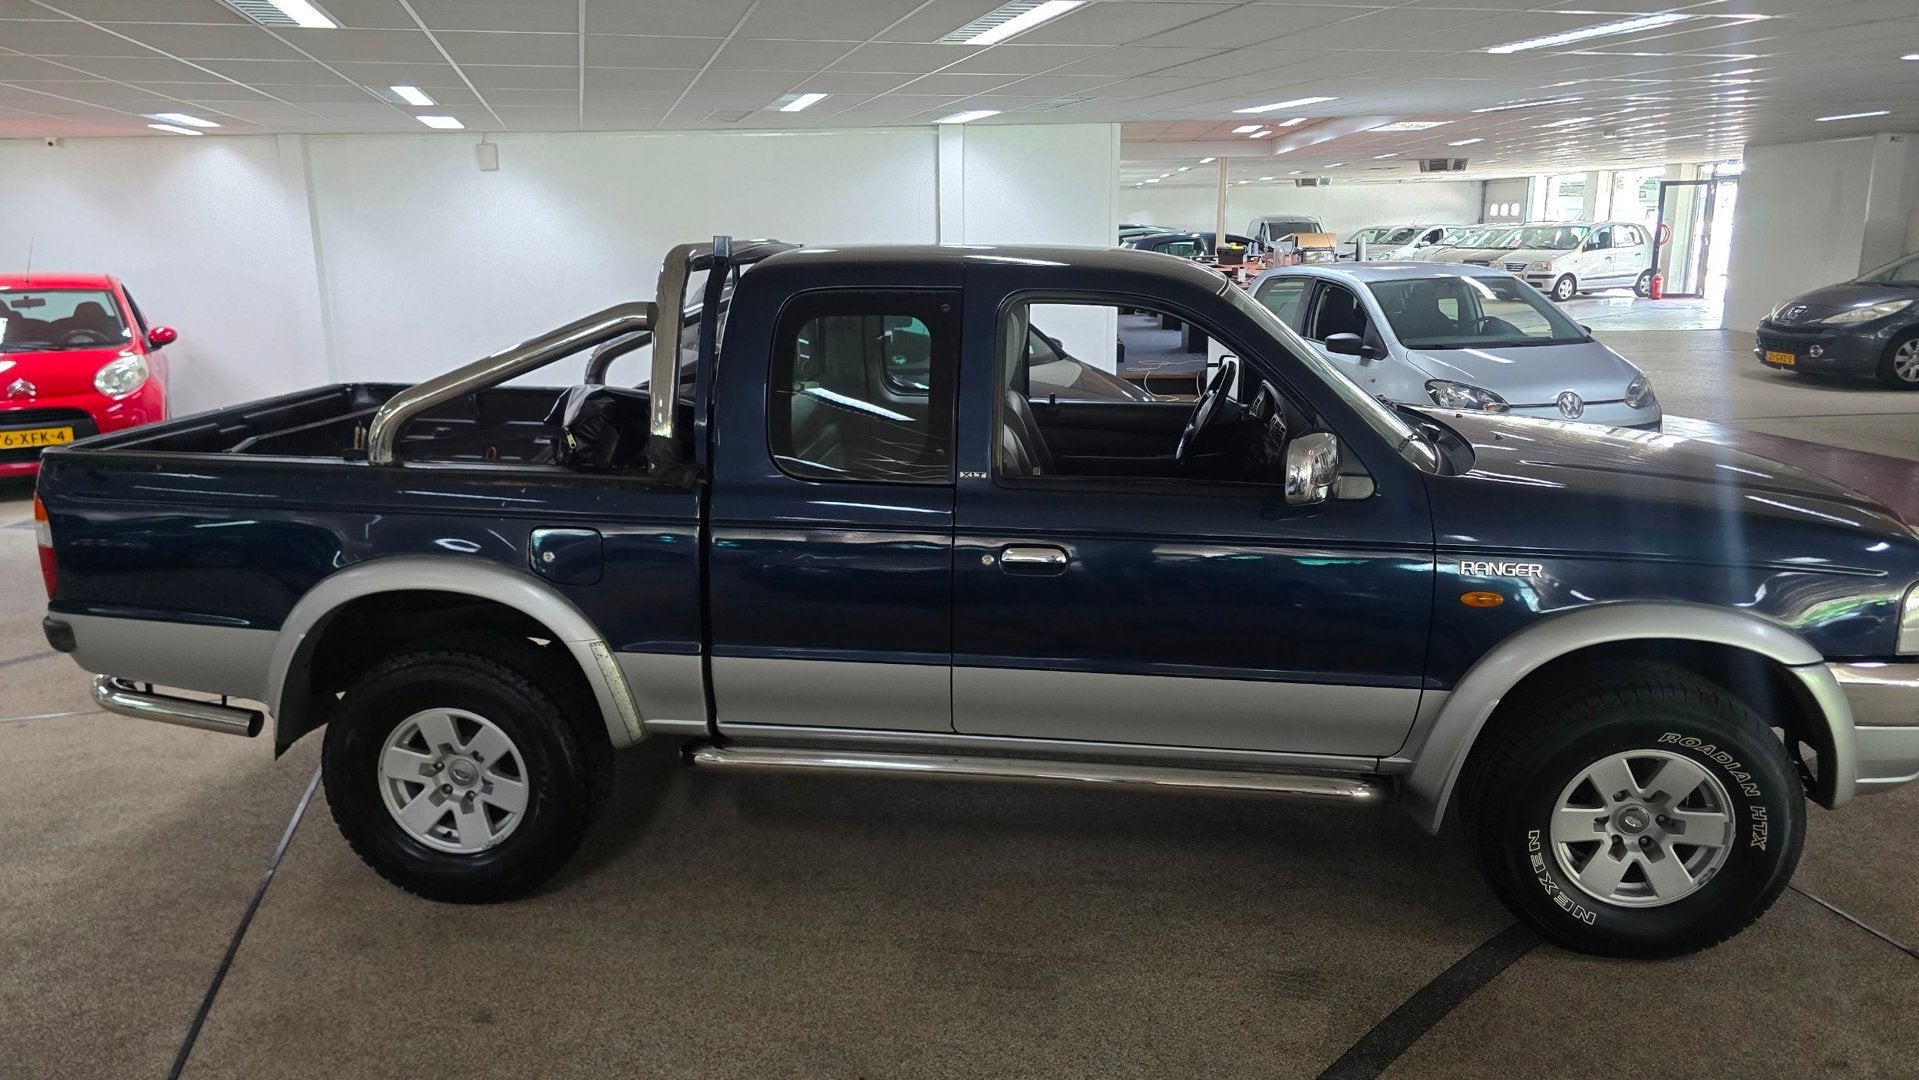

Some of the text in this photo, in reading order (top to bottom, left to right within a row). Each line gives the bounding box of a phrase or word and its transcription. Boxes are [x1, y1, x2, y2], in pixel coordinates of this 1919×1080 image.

[0, 430, 66, 446] 6-XFK-4
[1460, 560, 1543, 578] RANGER
[1657, 732, 1768, 851] ROADIAN HTX
[1528, 829, 1597, 926] NEXEN
